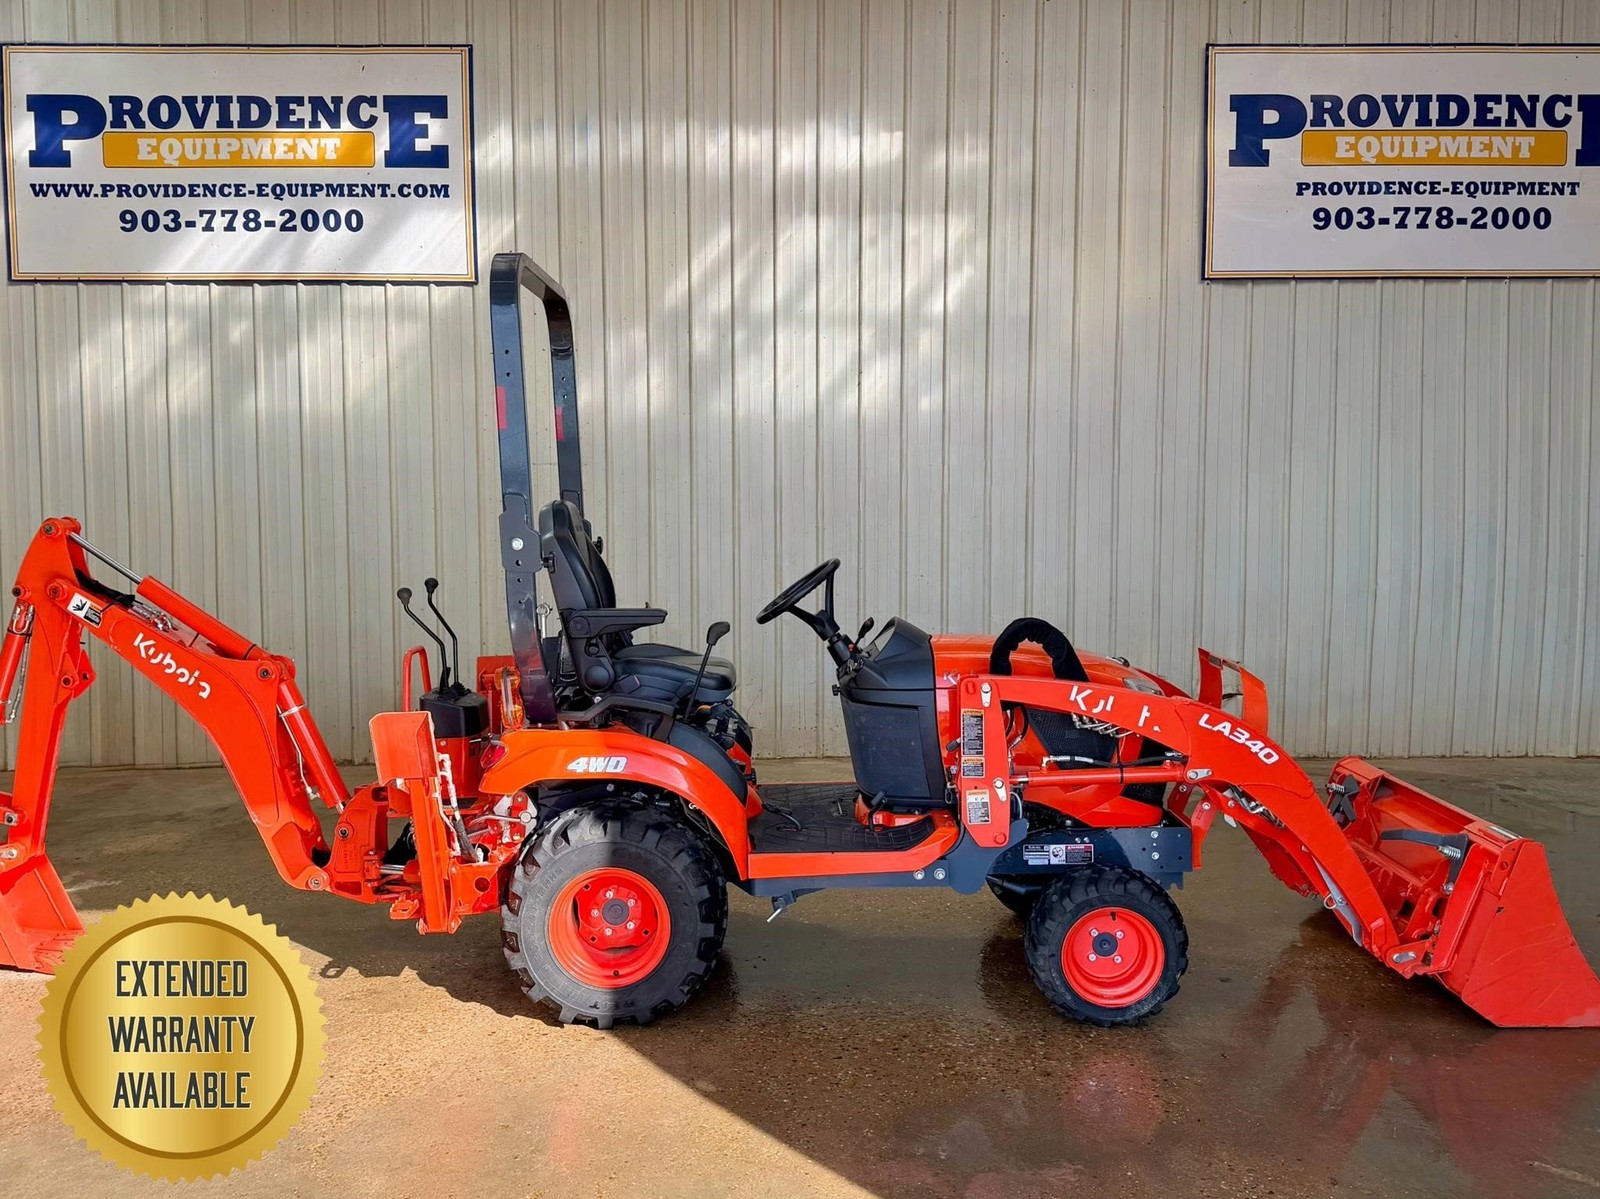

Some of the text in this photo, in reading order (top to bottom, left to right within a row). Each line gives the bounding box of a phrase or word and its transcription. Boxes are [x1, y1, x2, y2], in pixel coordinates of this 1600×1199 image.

[27, 94, 449, 168] PROVIDENCE
[137, 137, 341, 166] EQUIPMENT
[1335, 136, 1535, 164] EQUIPMENT
[29, 183, 450, 201] WWW.PROVIDENCE-EQUIPMENT.COM
[1296, 181, 1580, 199] PROVIDENCE-EQUIPMENT
[119, 208, 364, 232] 903-778-2000
[1312, 206, 1552, 230] 903-778-2000
[1198, 713, 1280, 765] LA340
[566, 756, 628, 773] 4WD
